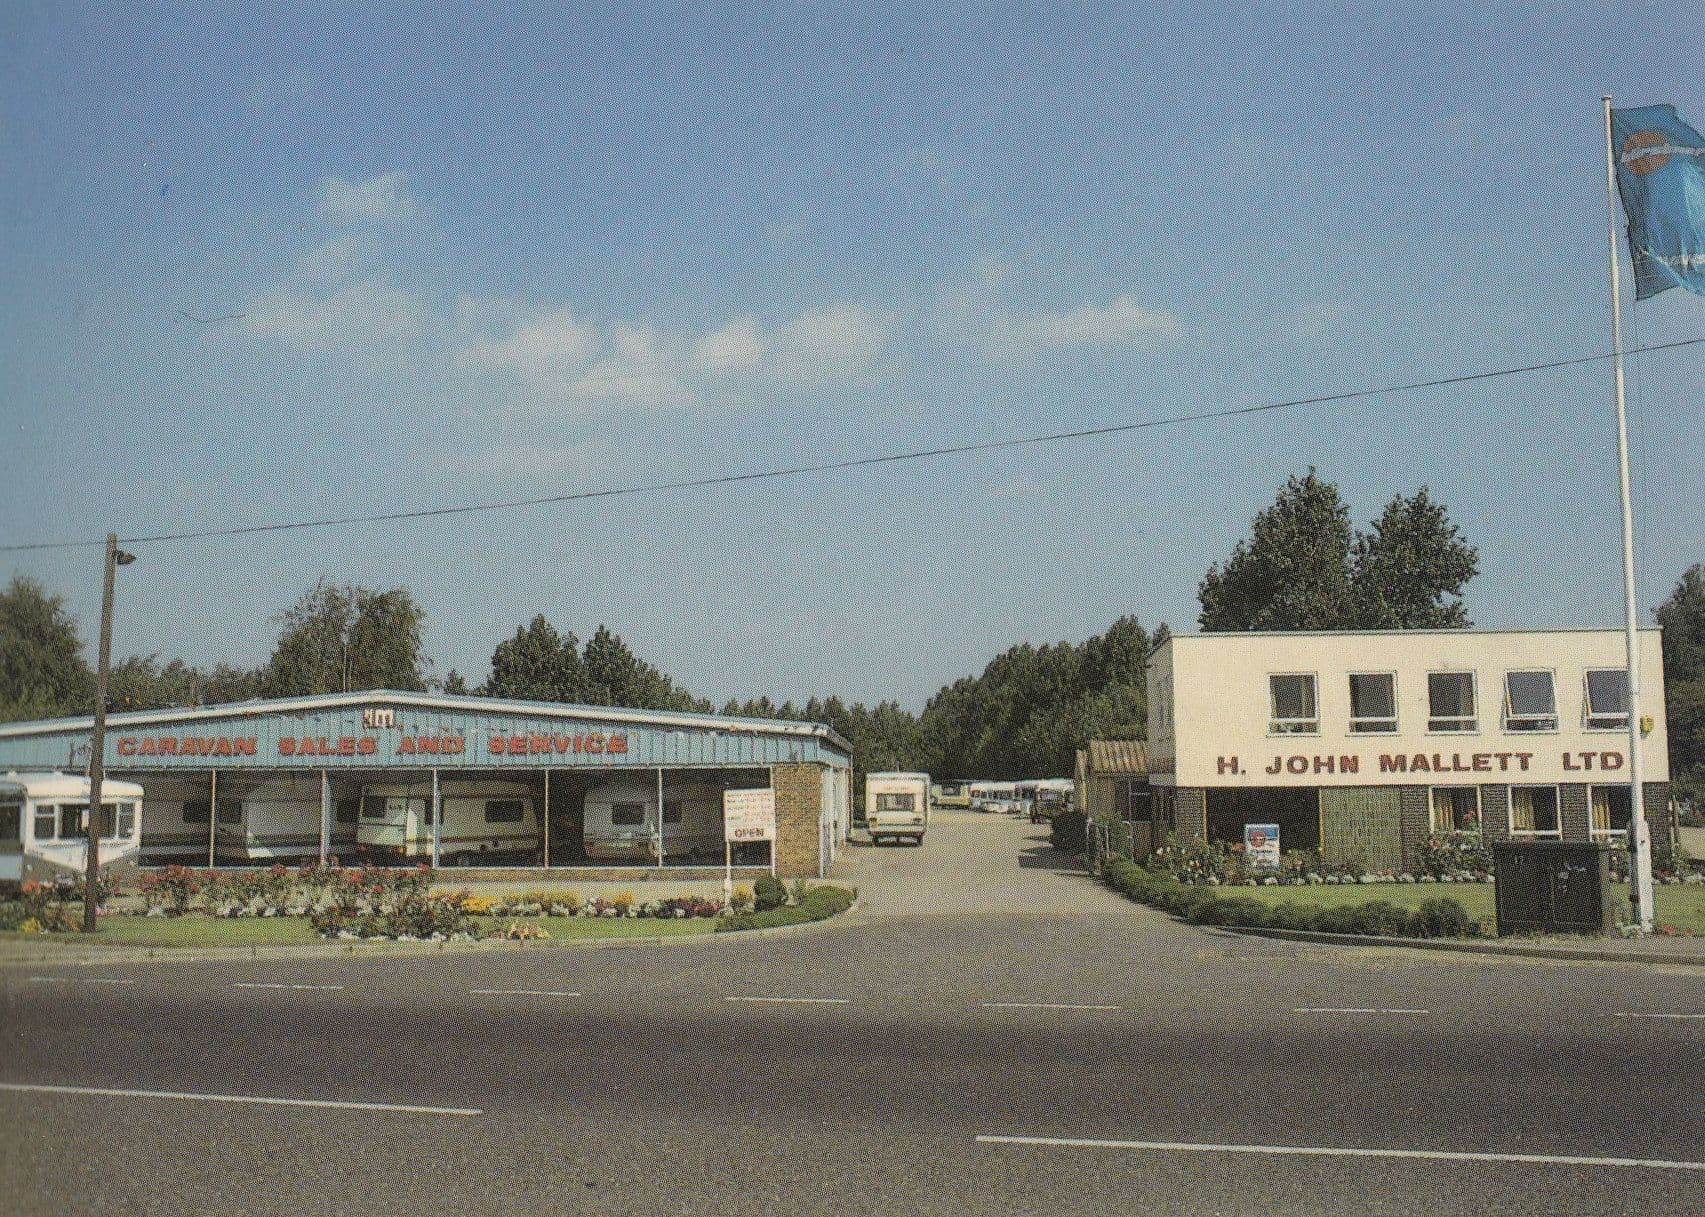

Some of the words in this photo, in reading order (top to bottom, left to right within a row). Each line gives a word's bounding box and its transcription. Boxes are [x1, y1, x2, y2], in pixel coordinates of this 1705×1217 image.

[117, 736, 257, 756] CARAVAN
[278, 736, 376, 756] SALES
[396, 735, 464, 754] AND
[488, 733, 629, 754] SERVICE
[1217, 755, 1247, 775] H.
[1265, 755, 1359, 775] JOHN
[1379, 752, 1533, 773] MALLETT
[1562, 751, 1624, 771] LTD
[734, 827, 764, 838] OPEN
